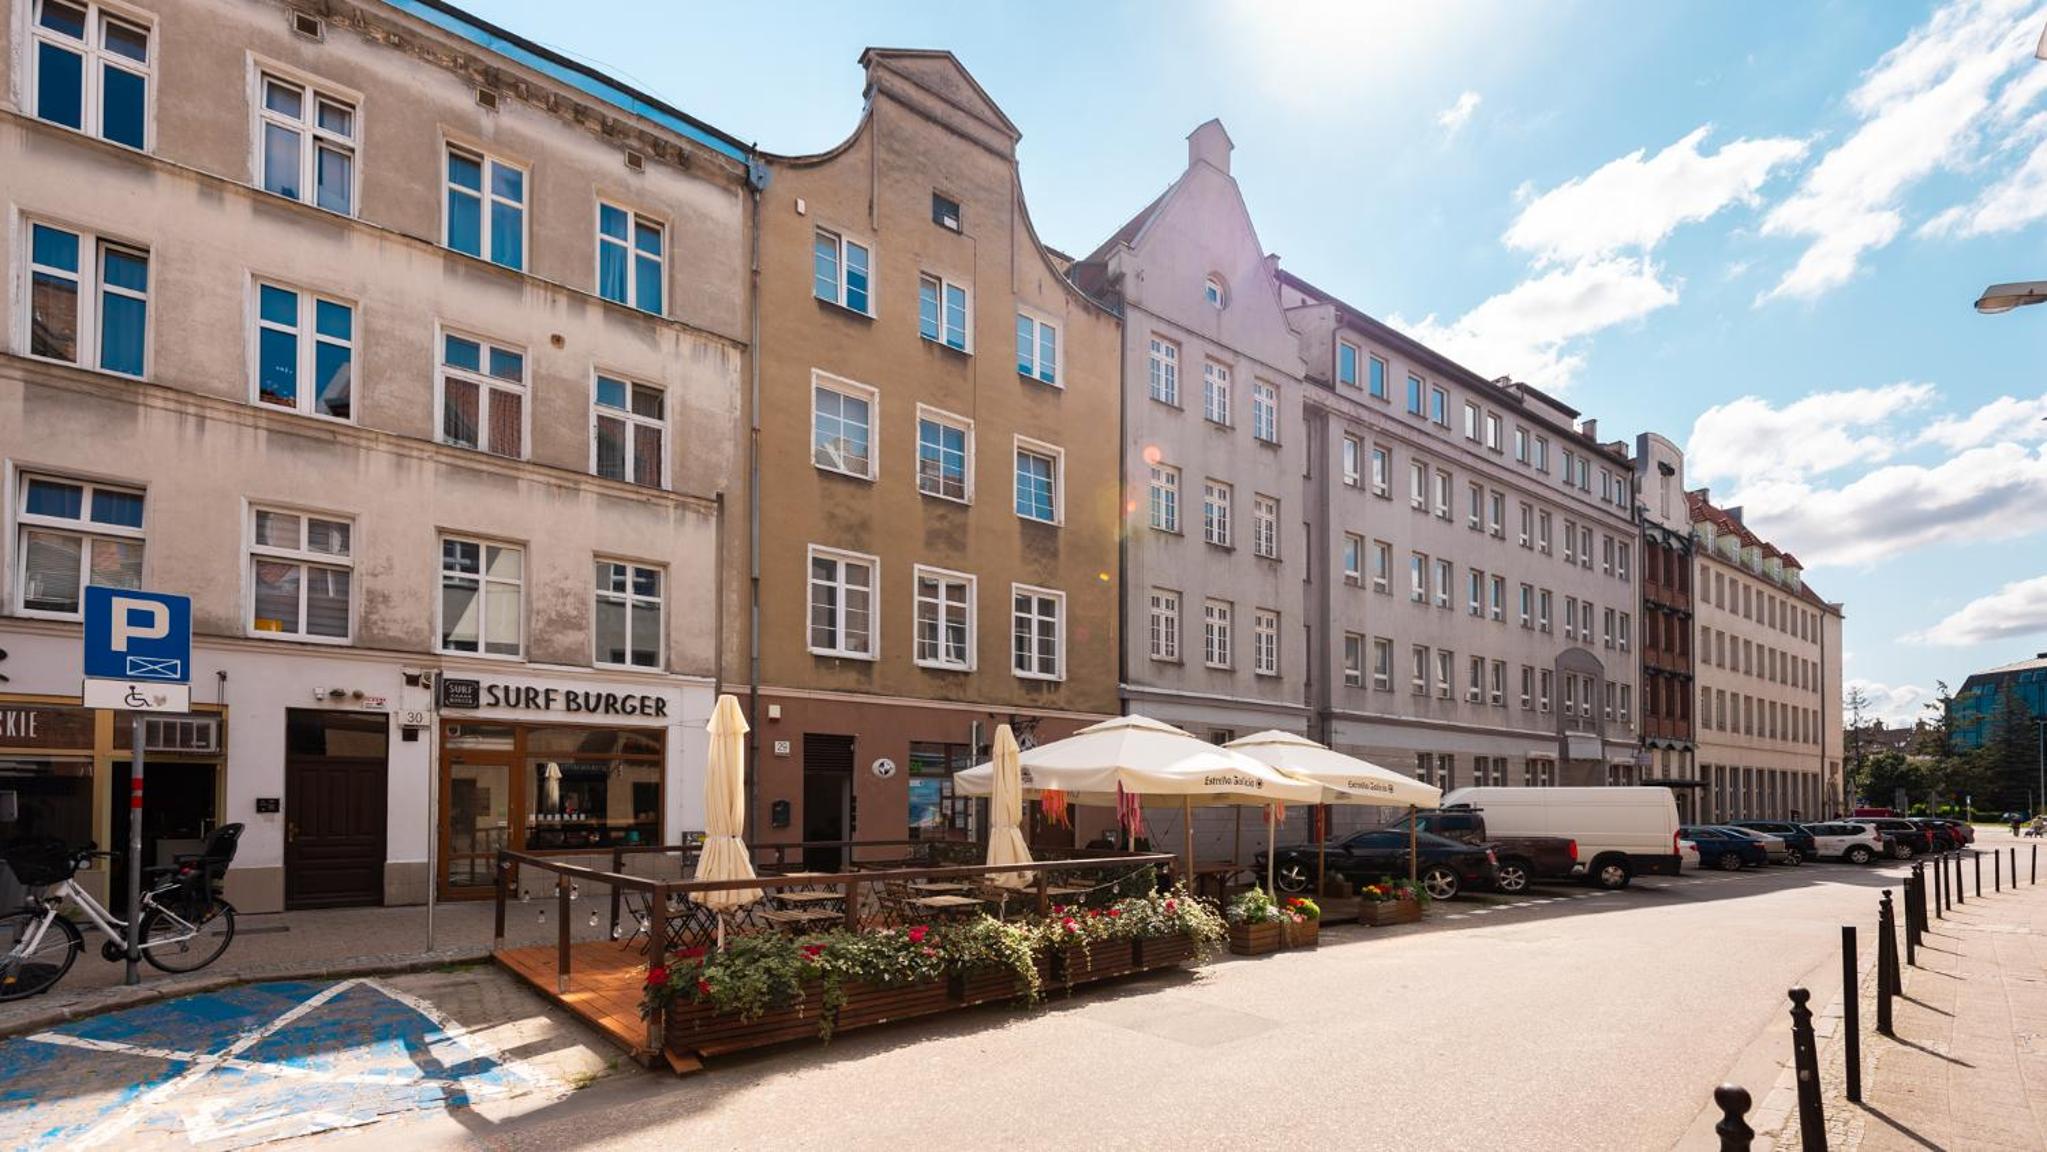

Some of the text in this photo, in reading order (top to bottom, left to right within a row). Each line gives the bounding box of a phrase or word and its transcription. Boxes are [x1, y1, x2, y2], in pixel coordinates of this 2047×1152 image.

[111, 597, 170, 652] P
[486, 684, 668, 717] SURF BURGER
[407, 712, 423, 723] 30
